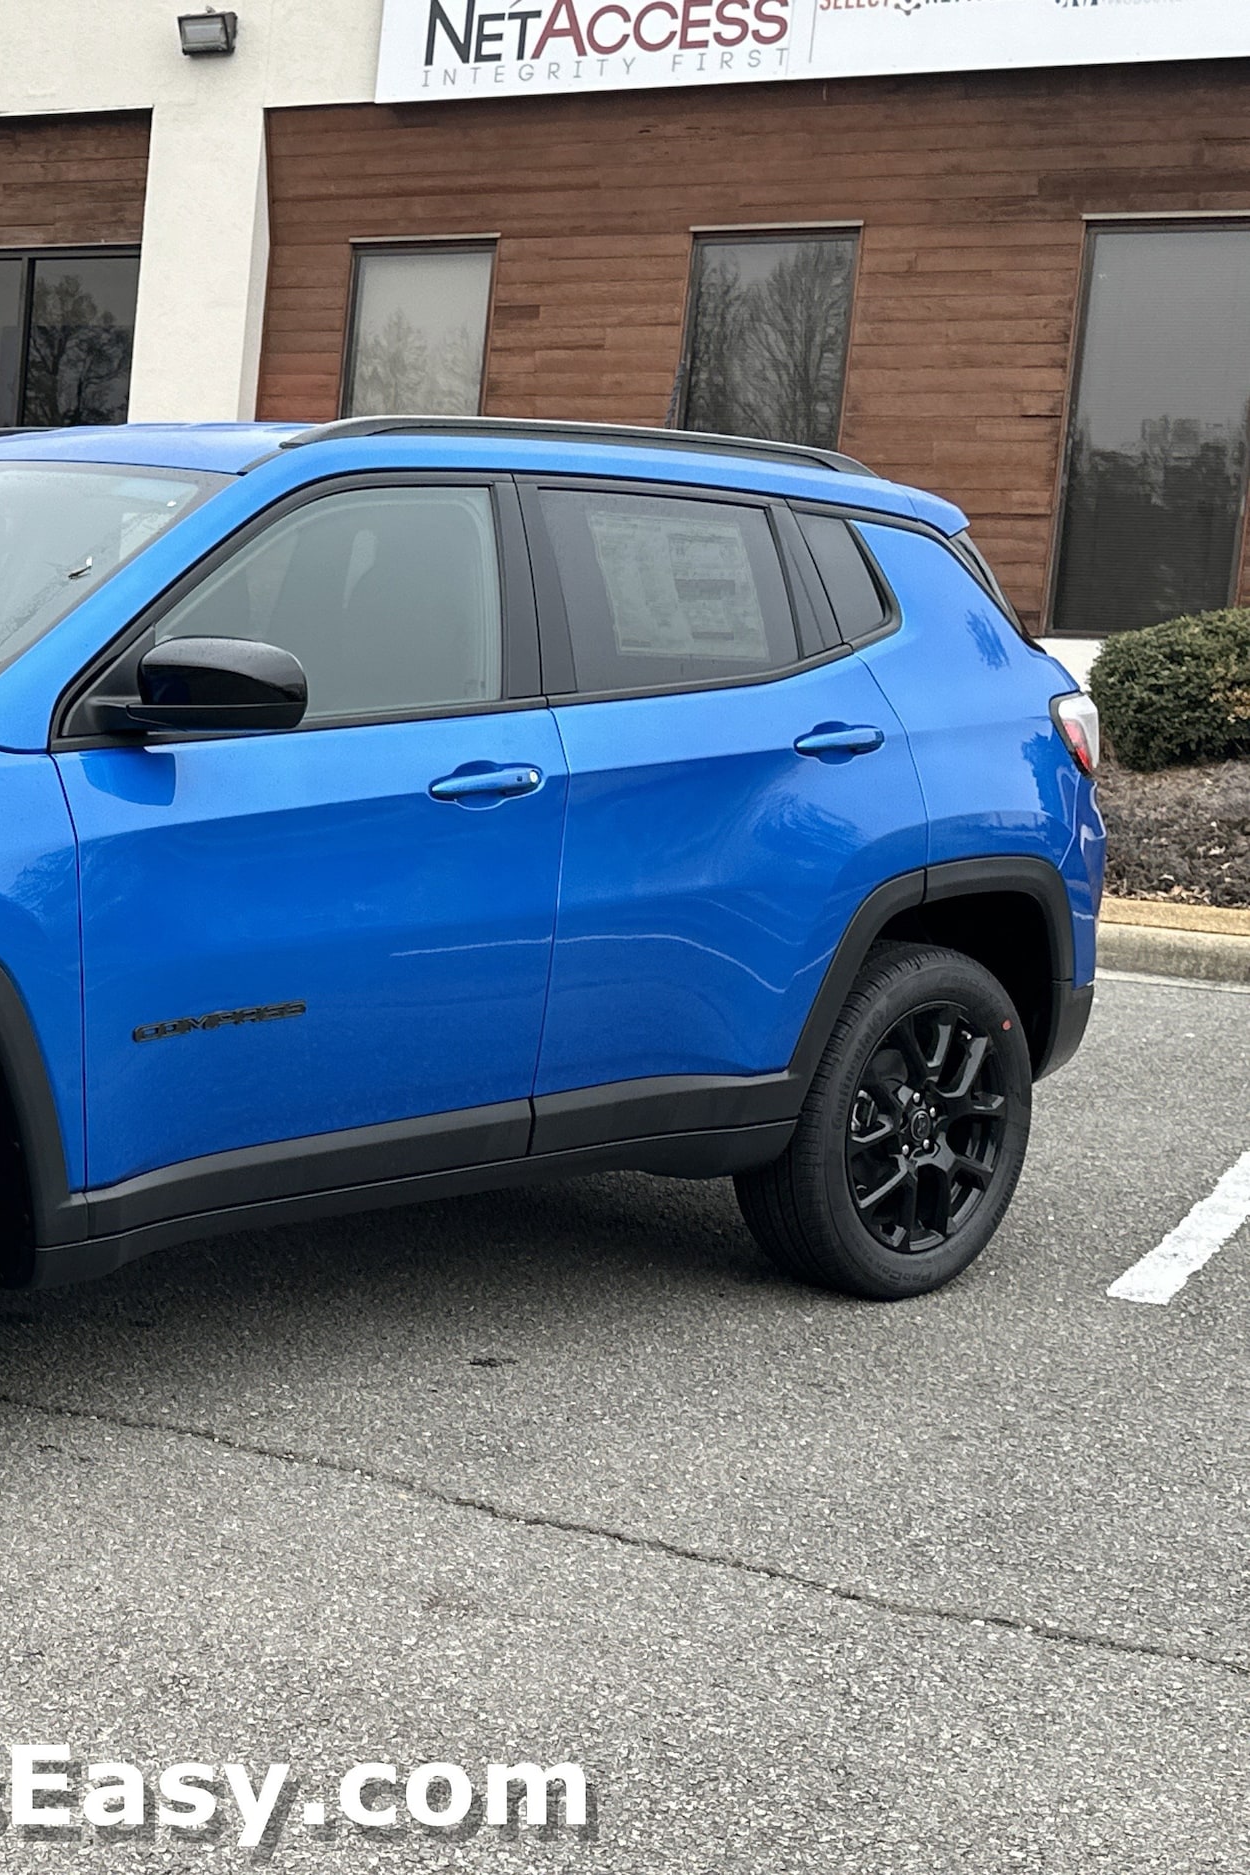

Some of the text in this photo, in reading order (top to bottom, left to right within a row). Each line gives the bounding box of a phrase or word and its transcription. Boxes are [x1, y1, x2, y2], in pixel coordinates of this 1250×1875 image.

[421, 47, 790, 88] INTEGRITY FIRST
[133, 1000, 306, 1043] COMPASS
